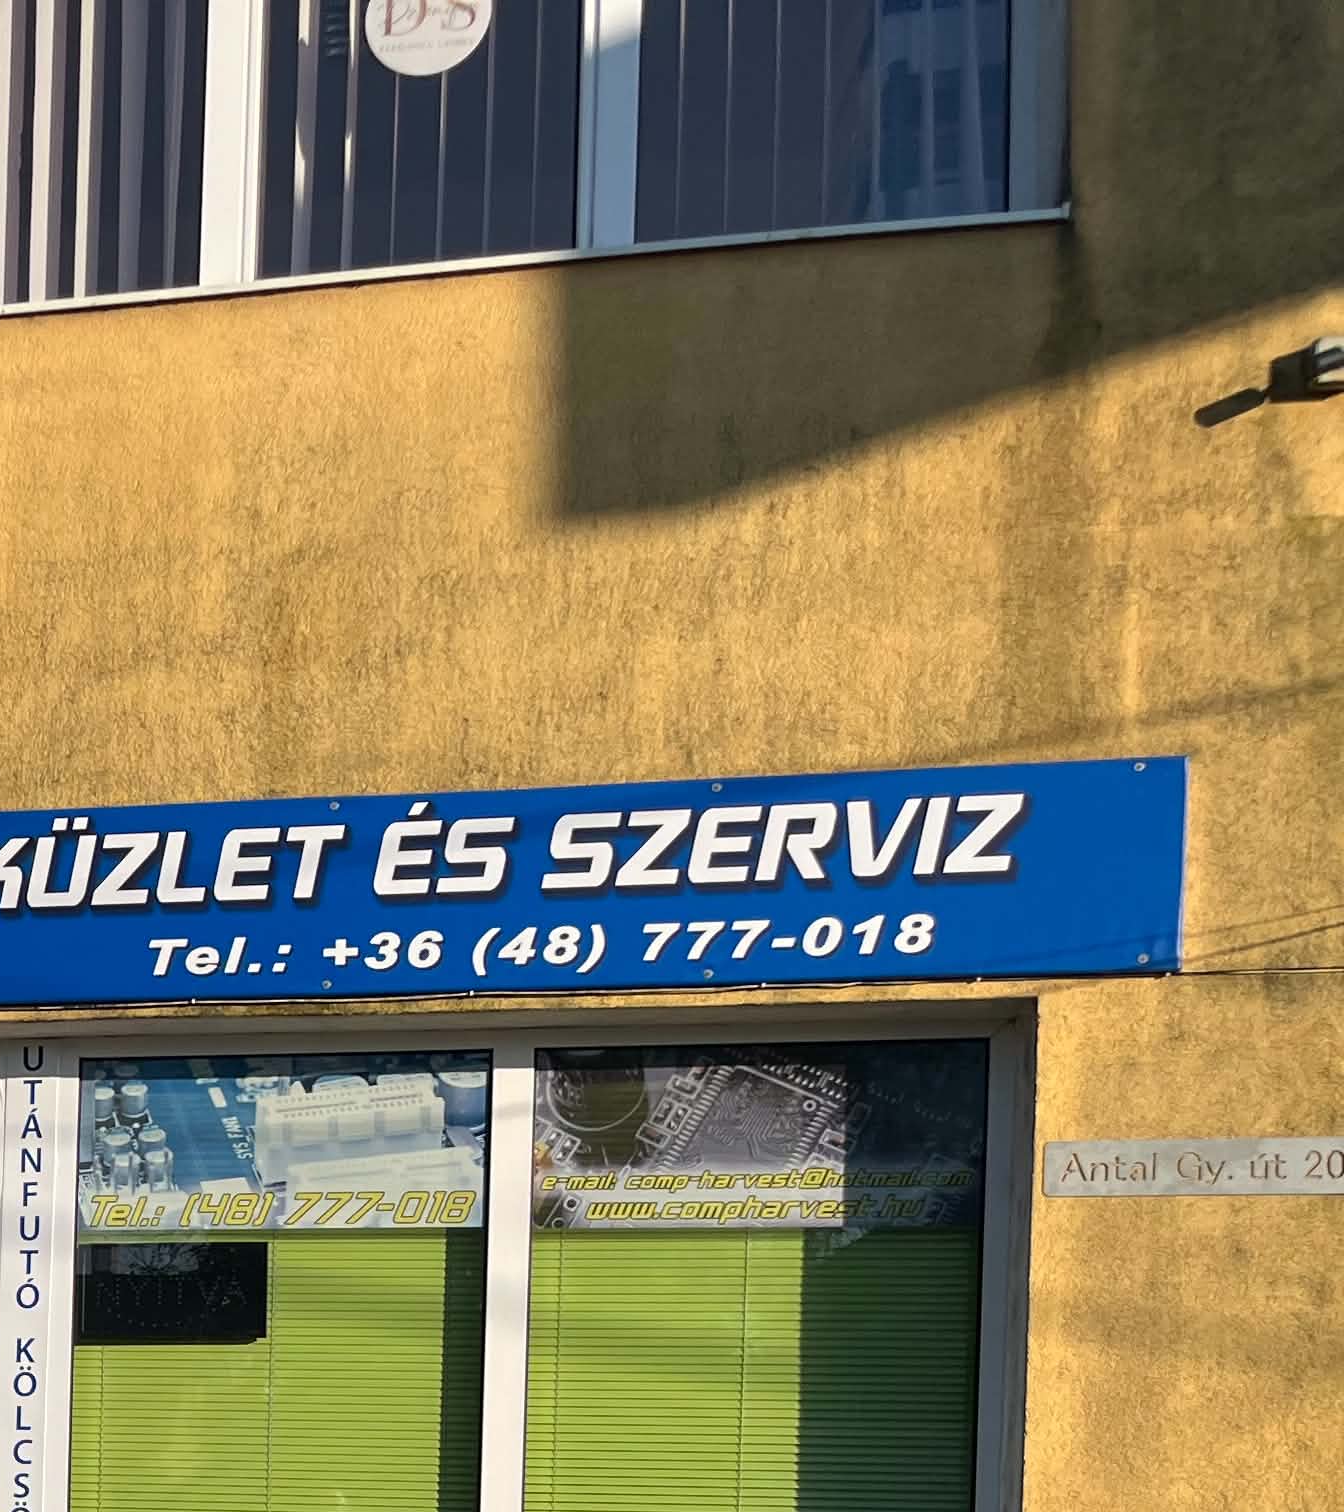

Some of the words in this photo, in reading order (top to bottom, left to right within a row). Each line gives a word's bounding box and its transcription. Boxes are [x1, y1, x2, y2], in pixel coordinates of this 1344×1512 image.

[373, 803, 515, 895] ÉS
[541, 792, 1027, 892] SZERVIZ
[150, 937, 291, 977] Tel.:
[321, 931, 443, 970] +36
[471, 925, 607, 973] (48)
[640, 914, 935, 964] 777-018
[16, 1045, 45, 1310] UTÁNFUTÓ
[542, 1173, 615, 1190] e-mail:
[625, 1168, 973, 1192] comp-harvest@hotmail.com
[1061, 1152, 1158, 1182] Antal
[1177, 1151, 1234, 1185] Gy.
[1250, 1153, 1288, 1180] út
[91, 1195, 165, 1227] Tel.:
[180, 1191, 275, 1226] (48)
[284, 1190, 477, 1225] 777-018
[586, 1195, 926, 1222] www.compharvest.hu
